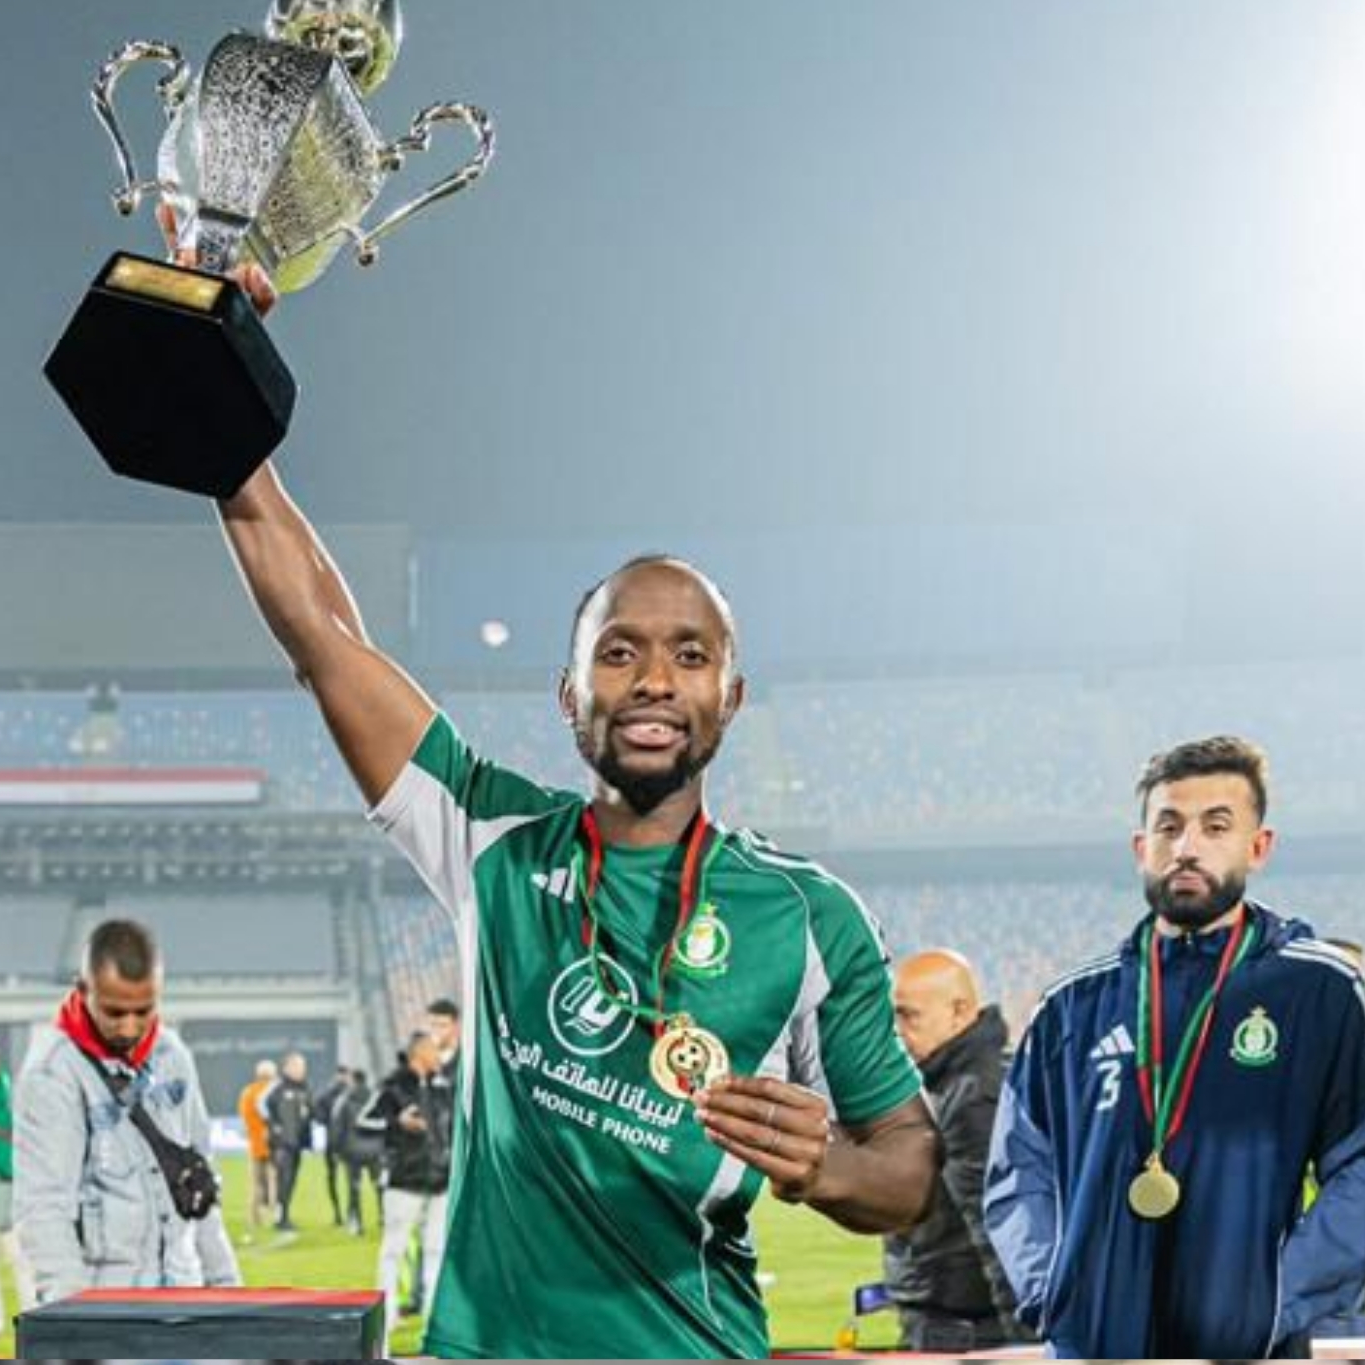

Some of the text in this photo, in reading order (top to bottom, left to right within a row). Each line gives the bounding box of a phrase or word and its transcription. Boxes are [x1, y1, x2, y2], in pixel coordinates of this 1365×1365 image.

[1095, 1061, 1121, 1111] 3
[532, 1085, 673, 1154] MOBILE PHONE
